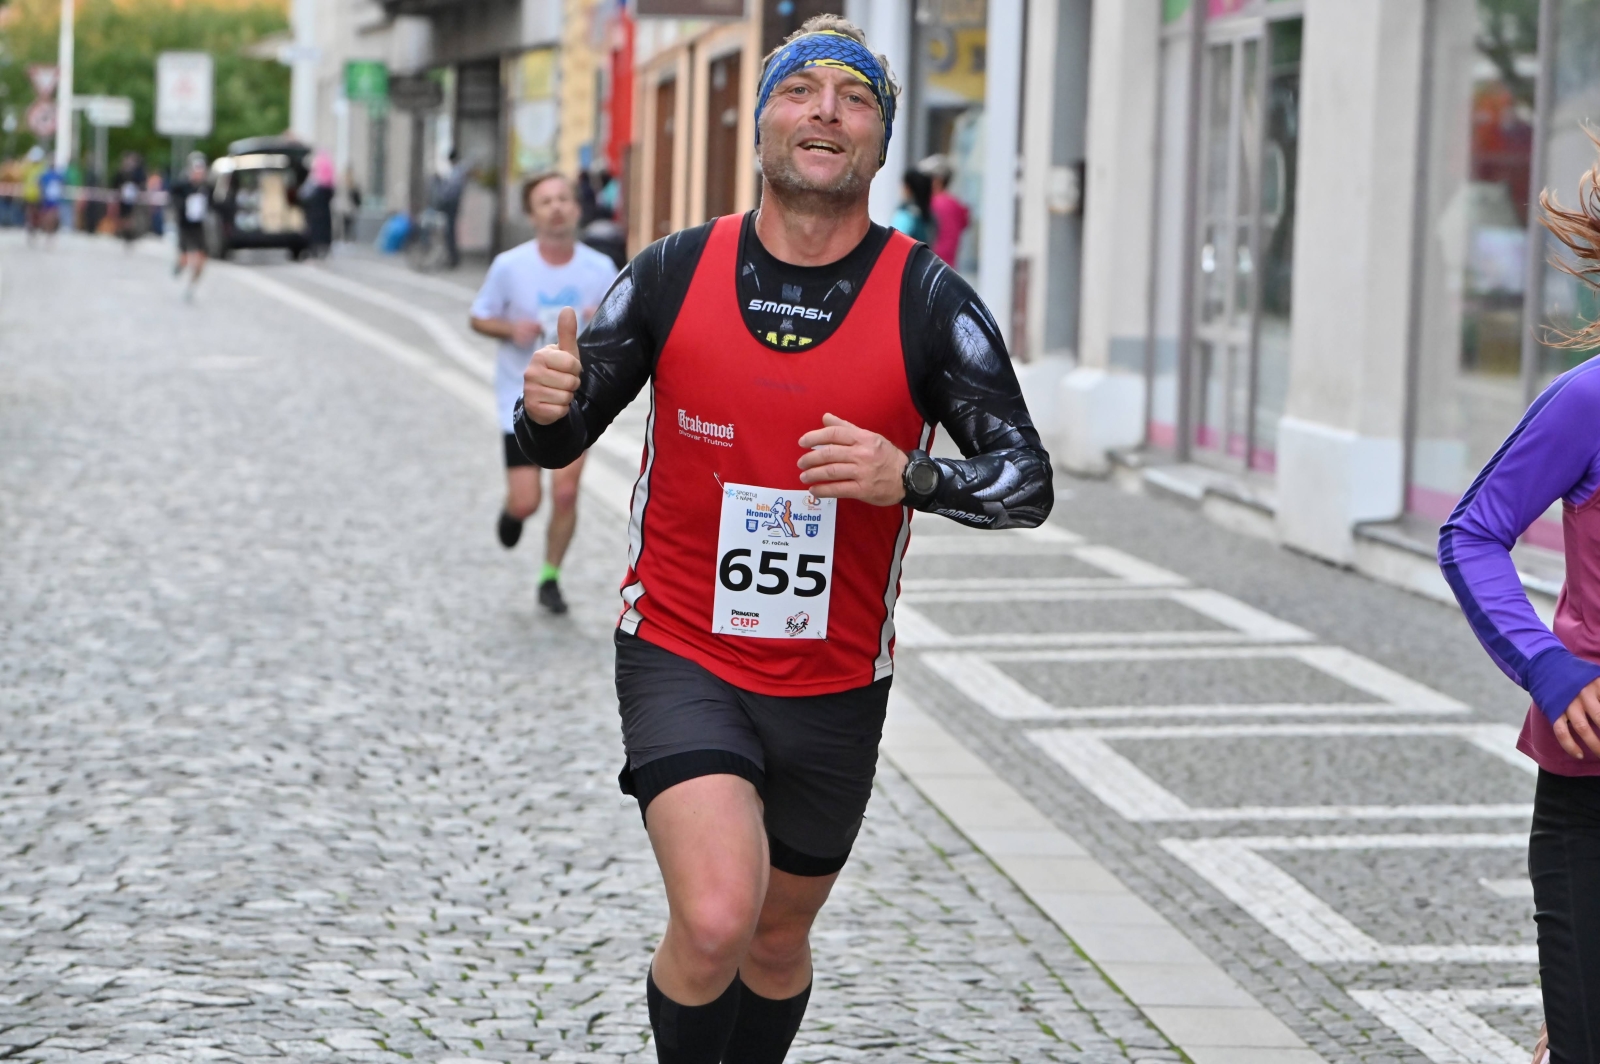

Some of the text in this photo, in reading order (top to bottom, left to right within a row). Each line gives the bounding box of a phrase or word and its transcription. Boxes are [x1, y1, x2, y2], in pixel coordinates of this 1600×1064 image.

[748, 299, 833, 322] SMMASH
[678, 408, 734, 440] Krakonoš
[703, 436, 733, 448] Trutnov
[756, 503, 770, 511] běh
[746, 508, 822, 522] Hronov Náchod
[933, 508, 996, 525] SMMASH
[719, 548, 826, 597] 655
[730, 617, 760, 628] CUP
